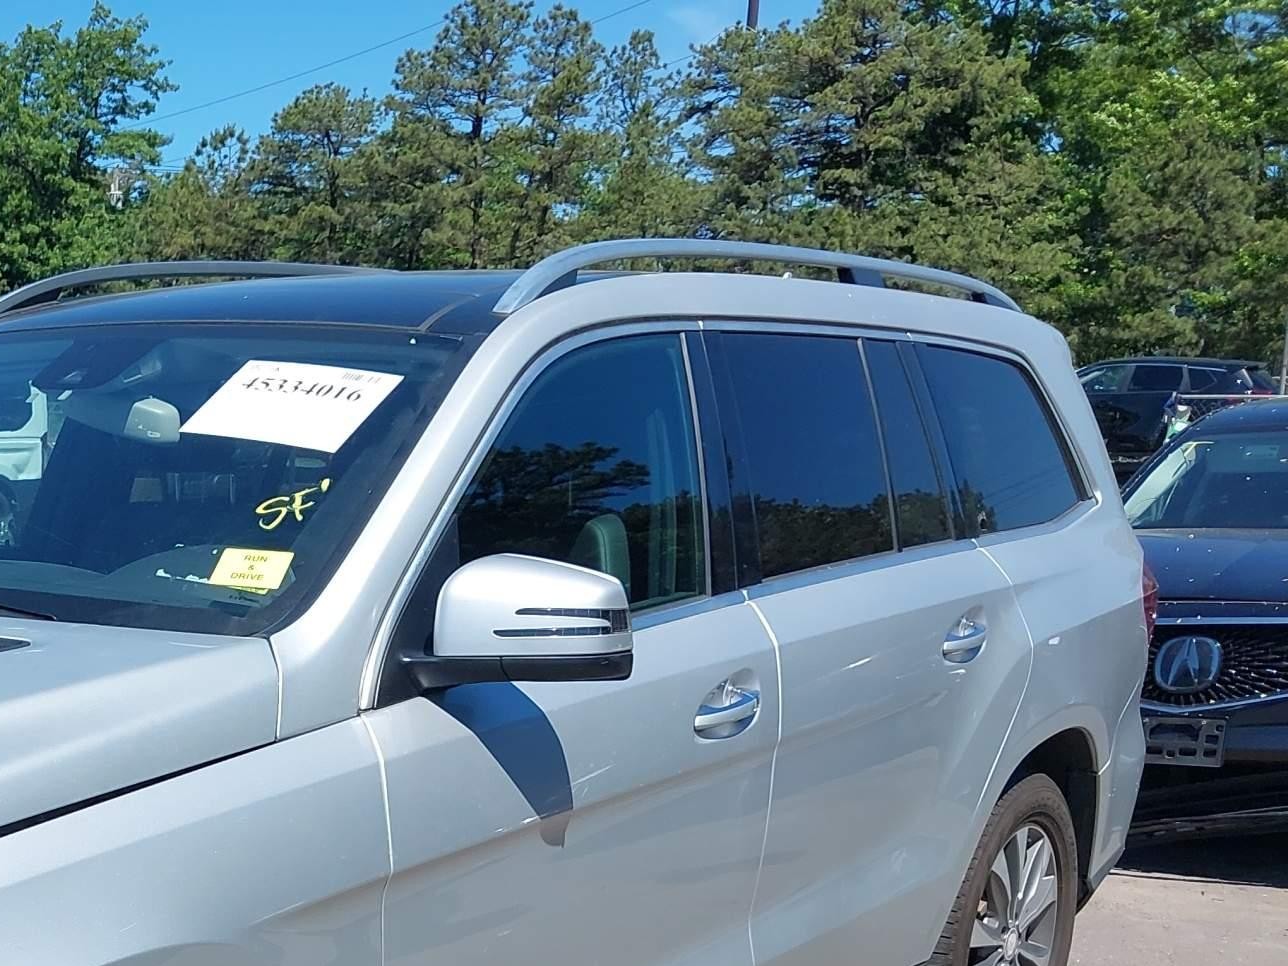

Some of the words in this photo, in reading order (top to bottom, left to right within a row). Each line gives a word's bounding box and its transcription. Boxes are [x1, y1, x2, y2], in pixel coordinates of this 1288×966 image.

[242, 377, 362, 402] 45334016
[243, 555, 269, 563] RUN
[230, 572, 264, 581] DRIVE
